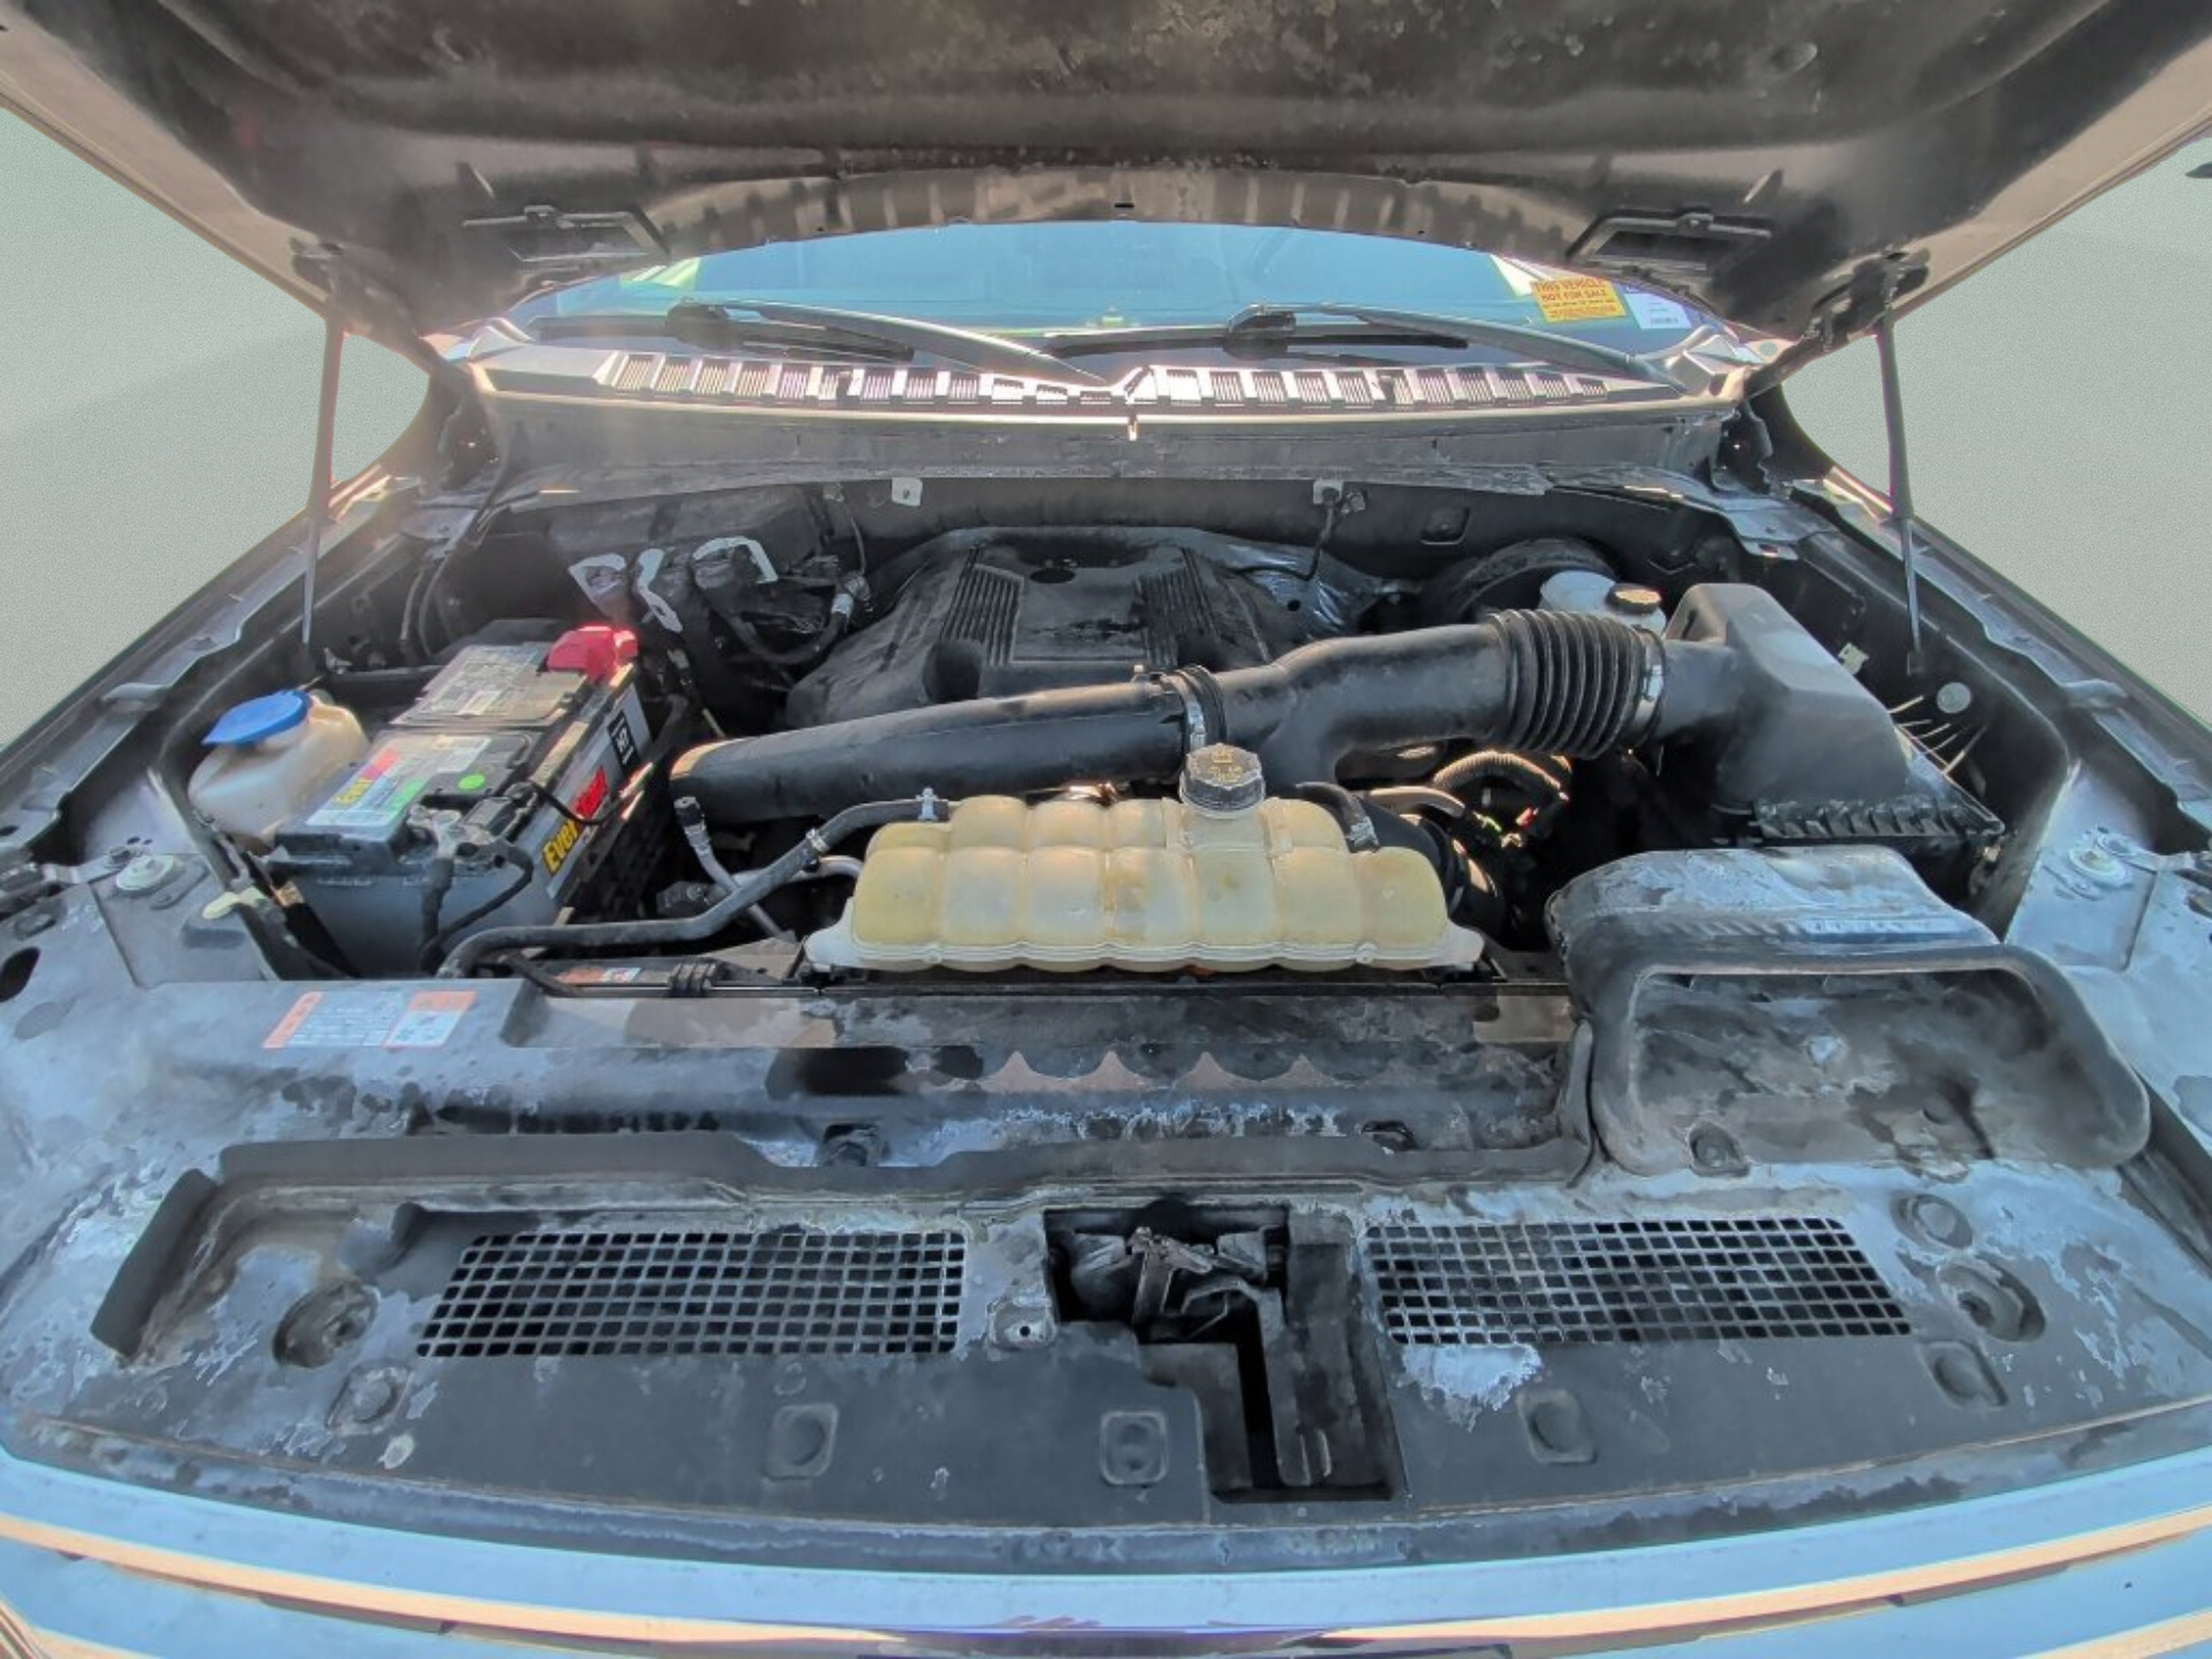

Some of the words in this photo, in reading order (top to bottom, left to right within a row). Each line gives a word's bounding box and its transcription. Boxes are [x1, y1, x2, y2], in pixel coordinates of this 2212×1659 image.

[1532, 281, 1561, 292] THIS
[1562, 277, 1605, 290] VEHICLE
[1541, 293, 1561, 301] NOT
[1564, 290, 1581, 300] FOR
[1584, 288, 1606, 298] SALE
